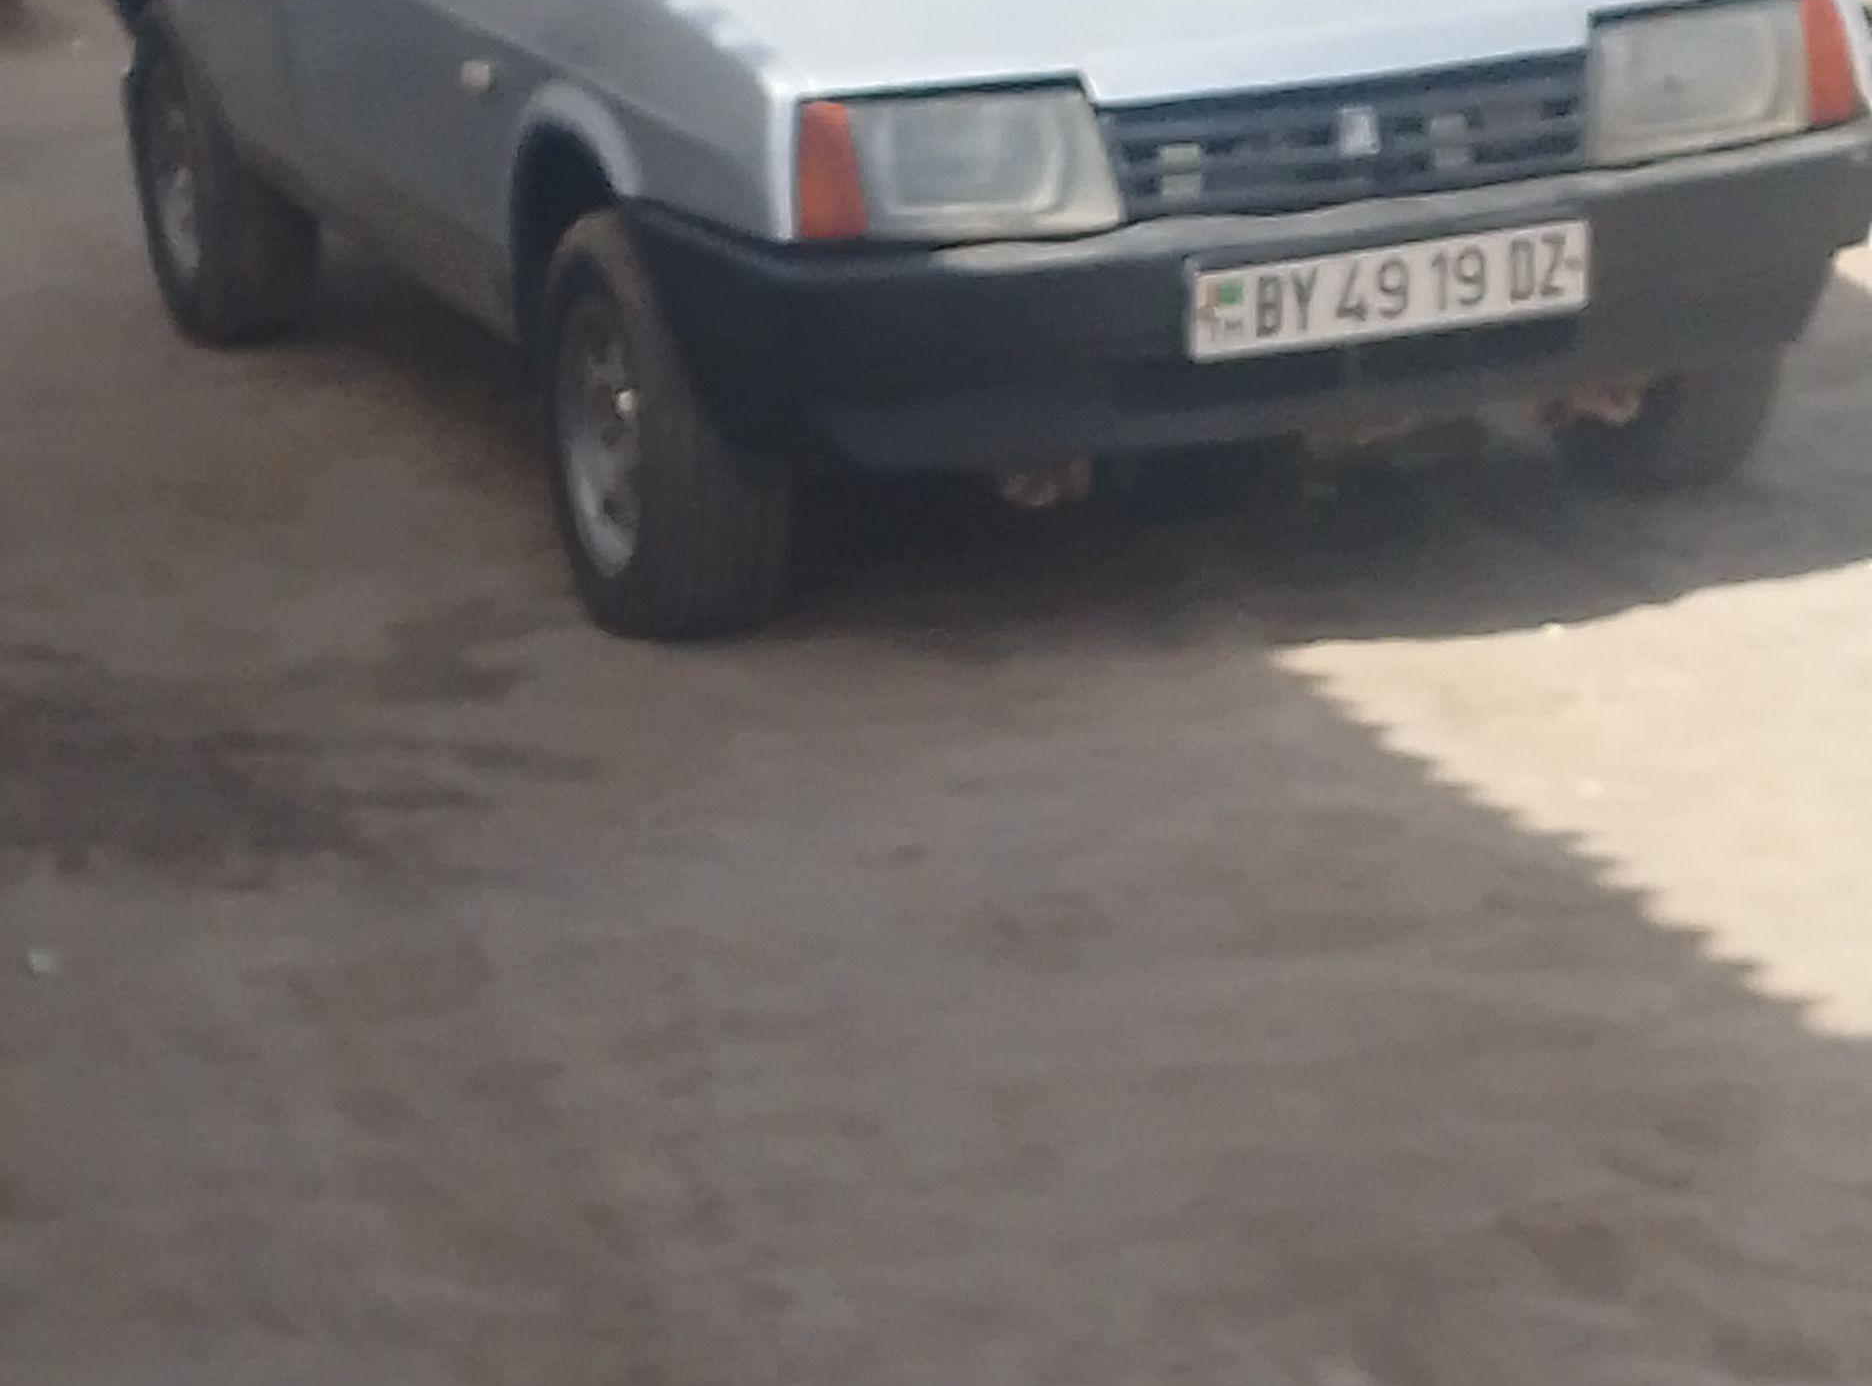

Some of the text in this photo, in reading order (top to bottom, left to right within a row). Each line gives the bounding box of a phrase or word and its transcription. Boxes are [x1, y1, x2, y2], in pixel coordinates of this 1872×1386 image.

[1256, 233, 1566, 337] BY 49 19 DZ
